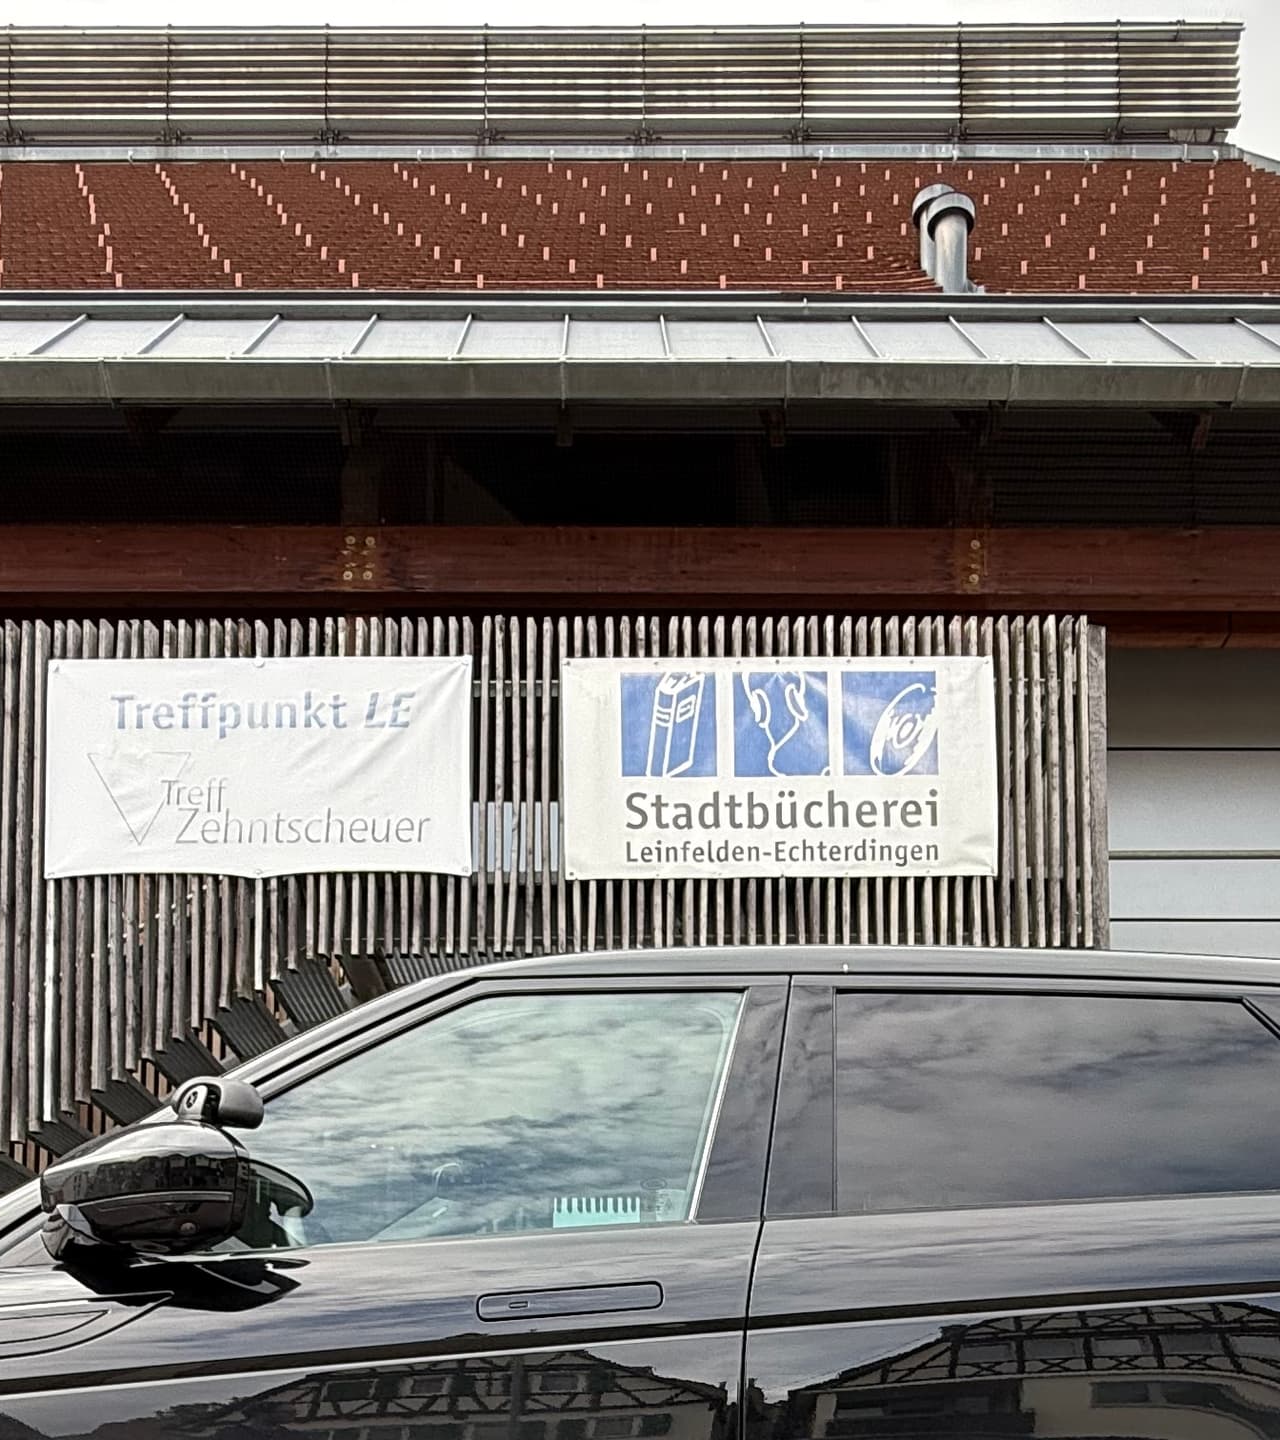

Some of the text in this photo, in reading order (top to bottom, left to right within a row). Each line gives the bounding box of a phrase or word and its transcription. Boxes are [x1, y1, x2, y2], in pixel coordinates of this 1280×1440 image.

[111, 690, 417, 740] Treffpunkt LE
[161, 777, 229, 813] Treff
[625, 788, 940, 830] Stadtbücherei
[175, 807, 431, 844] Zehntscheuer
[625, 838, 939, 867] Leinfelden-Echterdingen
